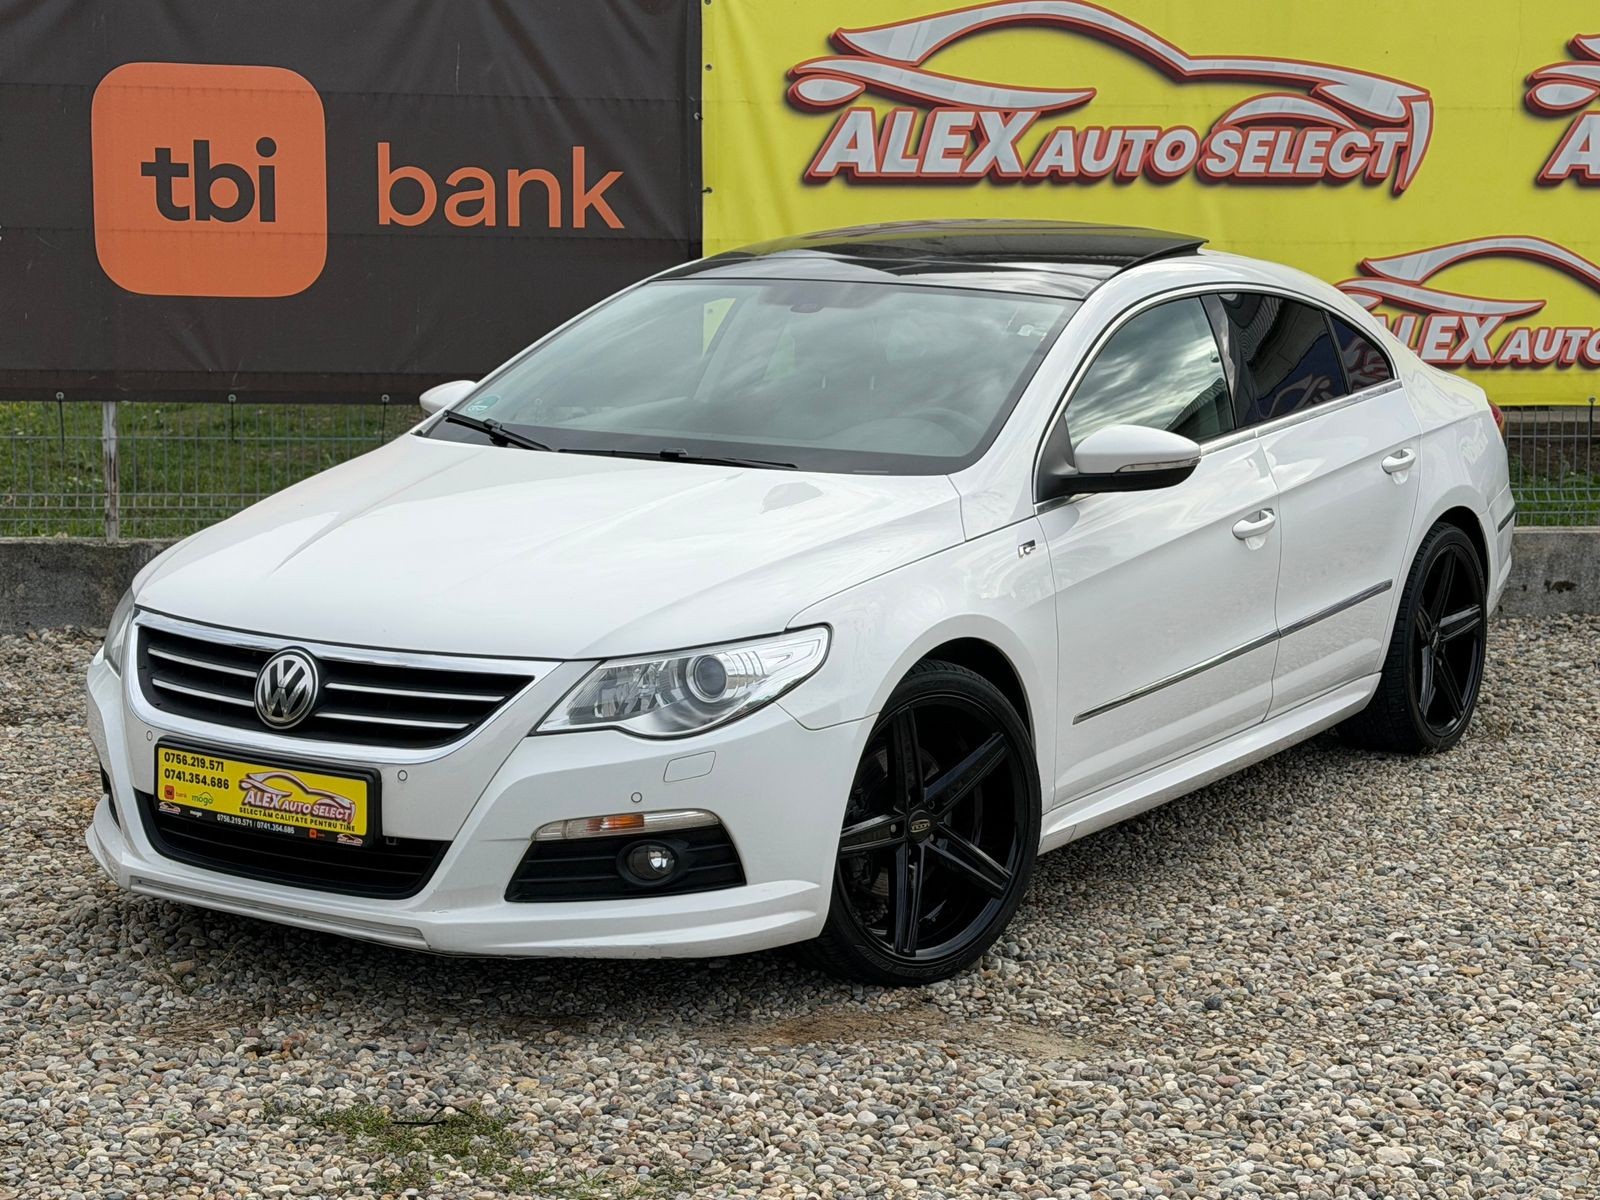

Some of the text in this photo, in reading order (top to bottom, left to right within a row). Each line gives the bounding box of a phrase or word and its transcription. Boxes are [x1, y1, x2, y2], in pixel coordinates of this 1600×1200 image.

[808, 108, 1411, 177] ALEX AUTO SELECT
[141, 137, 625, 229] tbi bank
[164, 752, 224, 772] 0756.219.571
[164, 768, 230, 789] 0741.354.686
[243, 790, 351, 821] ALEX AUTO SELECT
